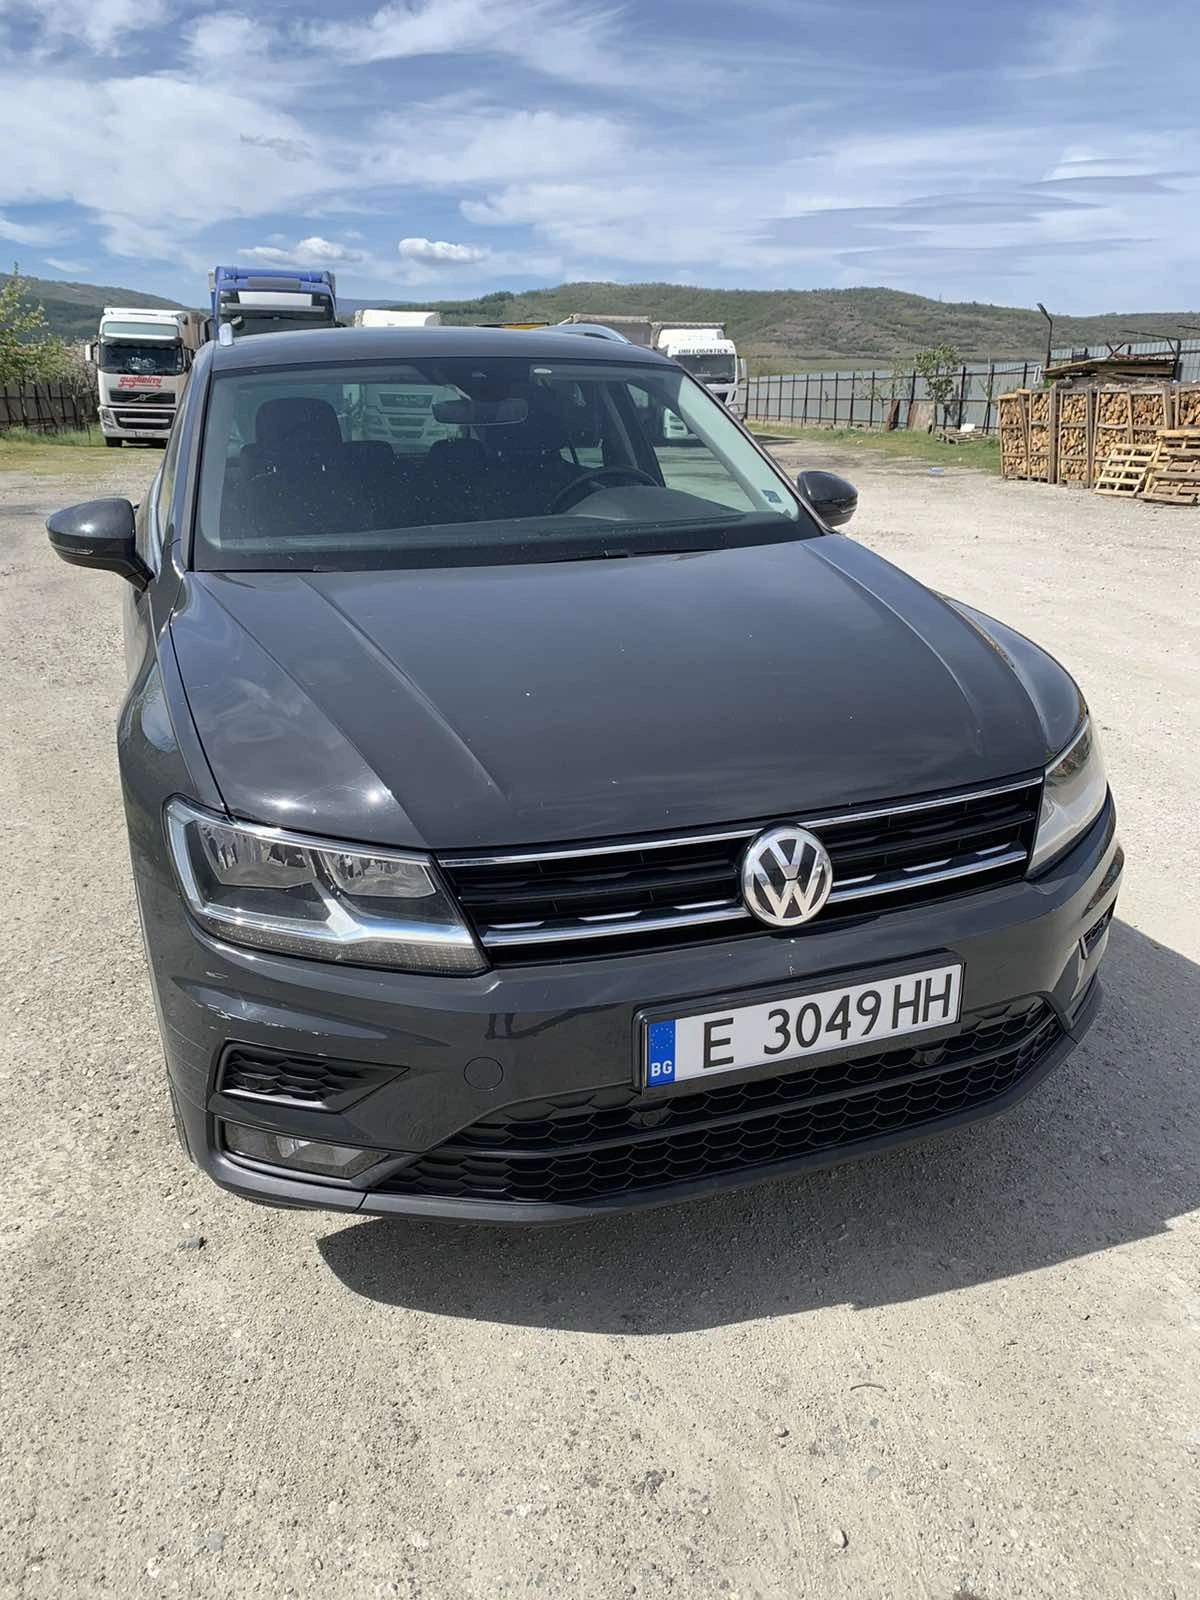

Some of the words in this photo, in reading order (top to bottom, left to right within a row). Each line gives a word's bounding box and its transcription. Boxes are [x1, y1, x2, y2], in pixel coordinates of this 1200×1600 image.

[703, 1017, 734, 1069] E
[763, 990, 882, 1055] 3049
[891, 973, 953, 1029] HH
[651, 1060, 673, 1077] BG
